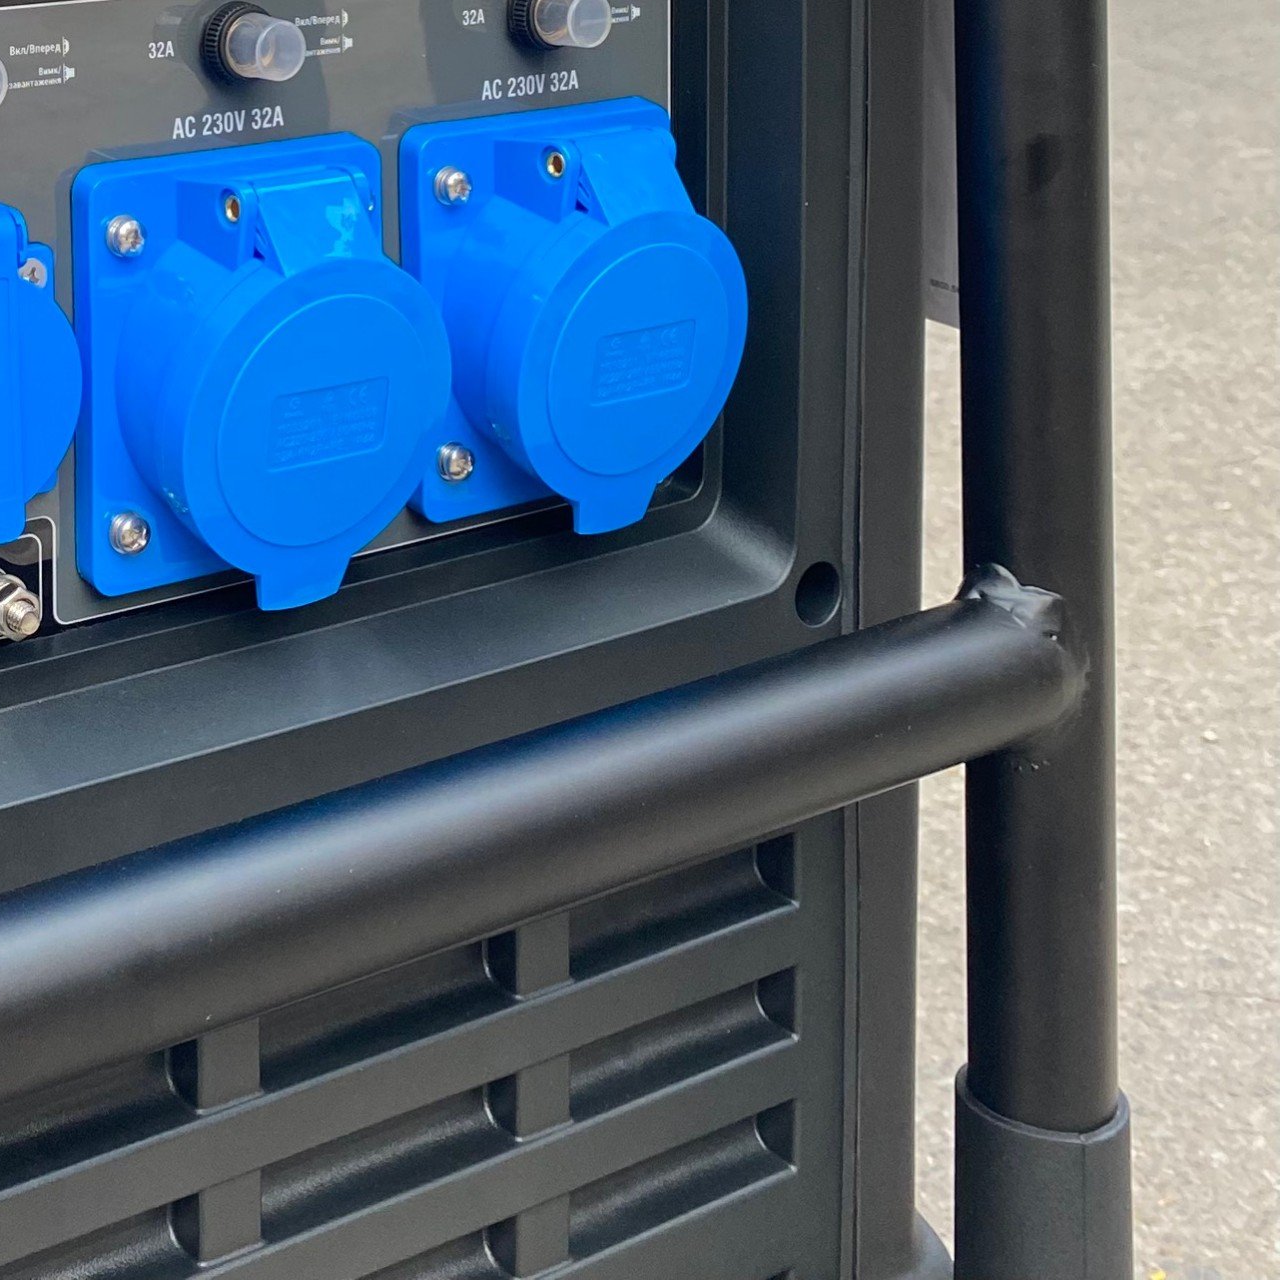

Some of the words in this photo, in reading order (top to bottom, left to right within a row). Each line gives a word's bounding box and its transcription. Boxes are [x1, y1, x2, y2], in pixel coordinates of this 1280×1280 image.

[462, 10, 486, 26] 32A
[9, 42, 62, 57] Вкл/Вперед
[148, 40, 175, 59] 32A
[481, 77, 504, 101] AC
[507, 73, 547, 97] 230V
[548, 69, 579, 92] 32A
[173, 114, 198, 140] AC
[201, 109, 247, 136] 230V
[250, 104, 284, 131] 32A
